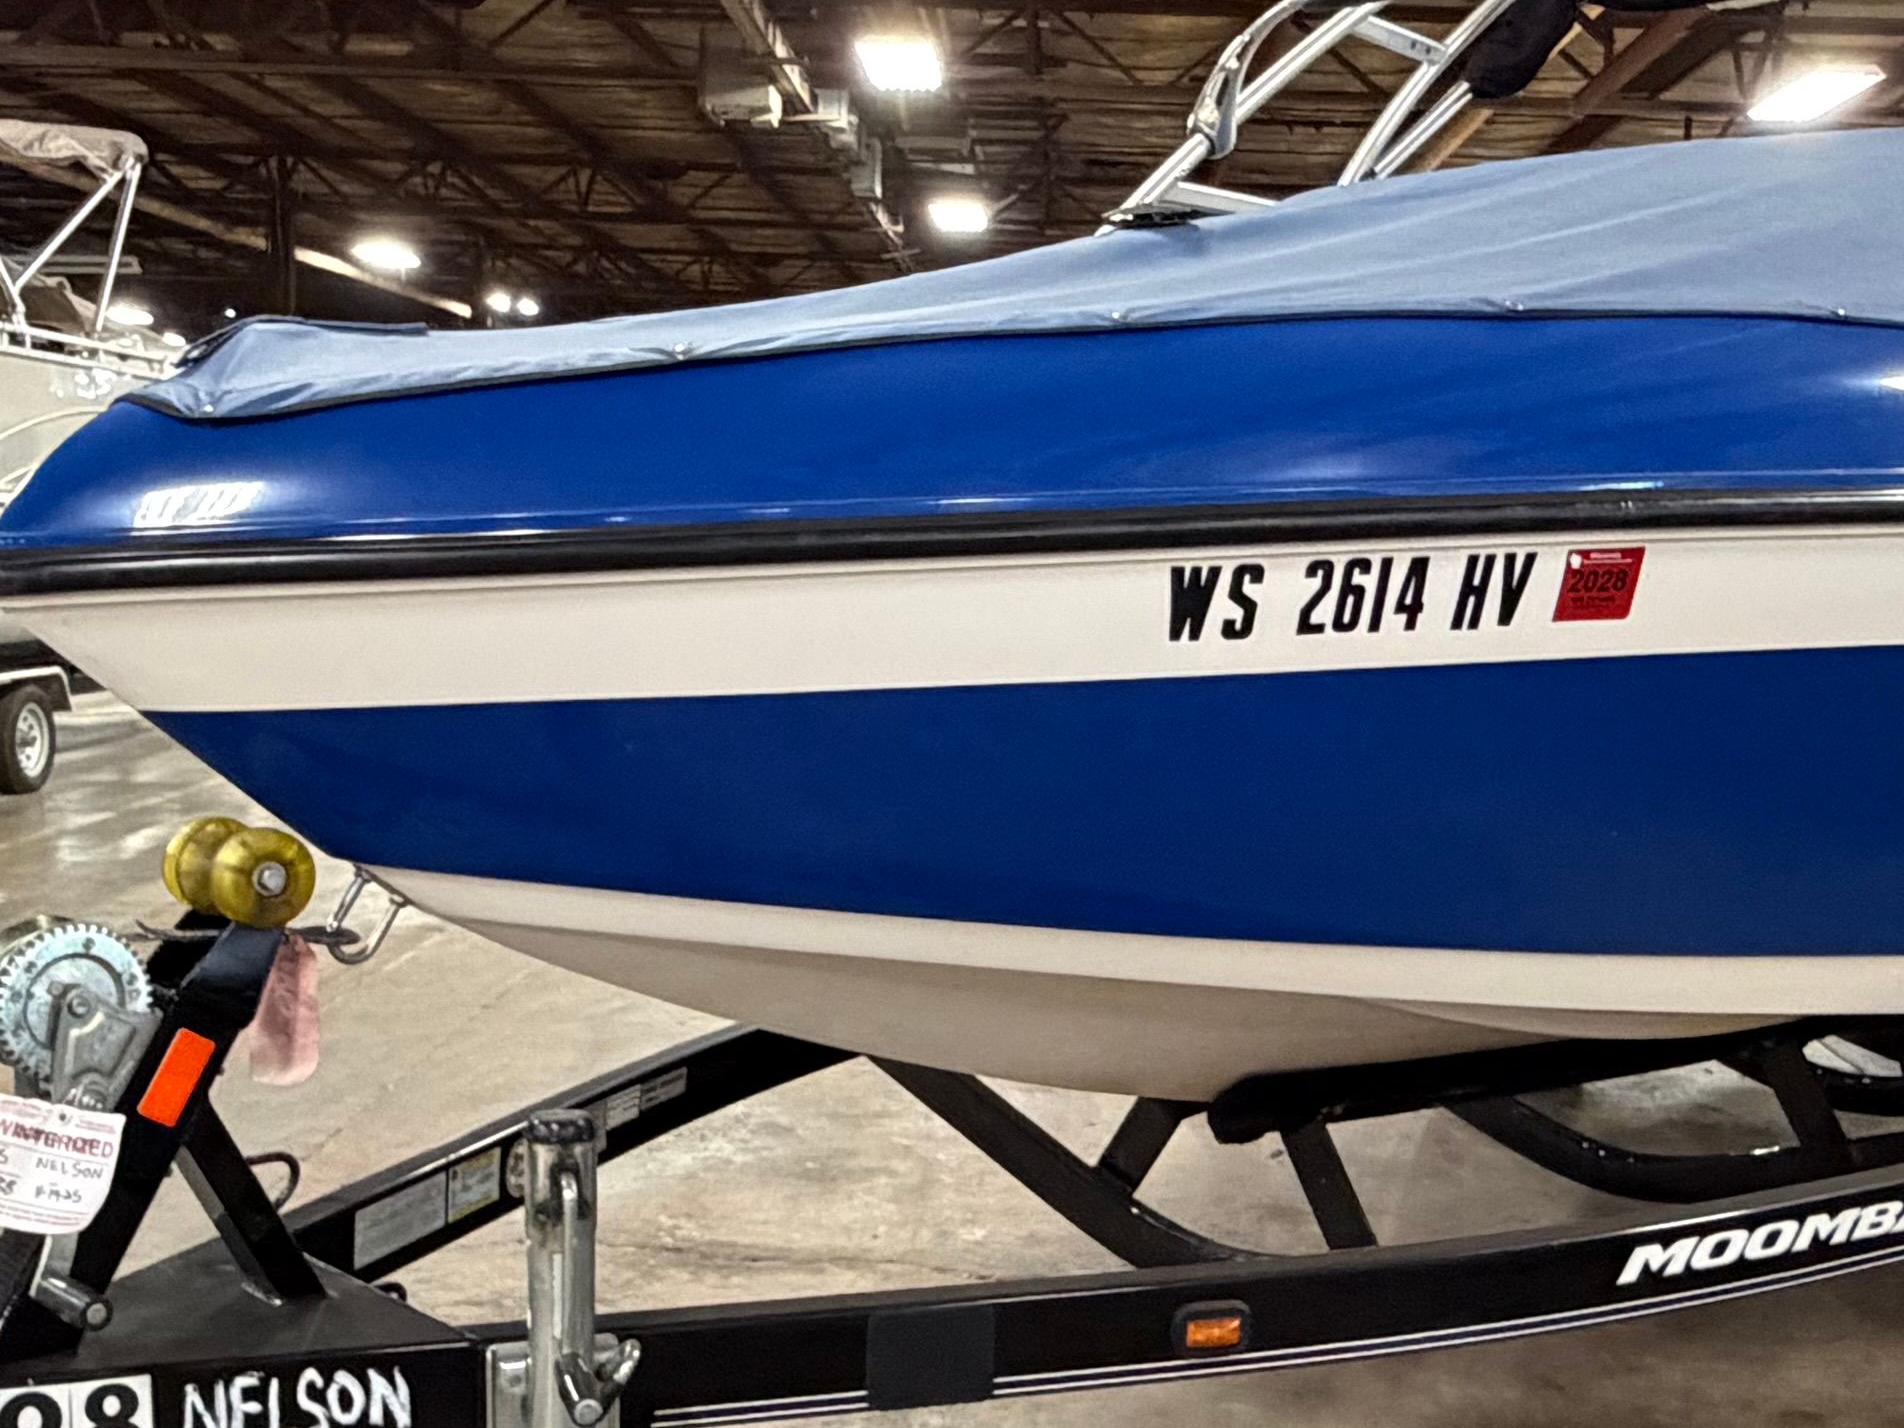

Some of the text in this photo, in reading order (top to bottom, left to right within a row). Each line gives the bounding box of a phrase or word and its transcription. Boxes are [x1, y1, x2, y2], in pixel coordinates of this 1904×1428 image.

[1567, 568, 1629, 593] 2028
[1168, 552, 1538, 641] WS 2614 HV
[36, 1157, 104, 1179] NELSON
